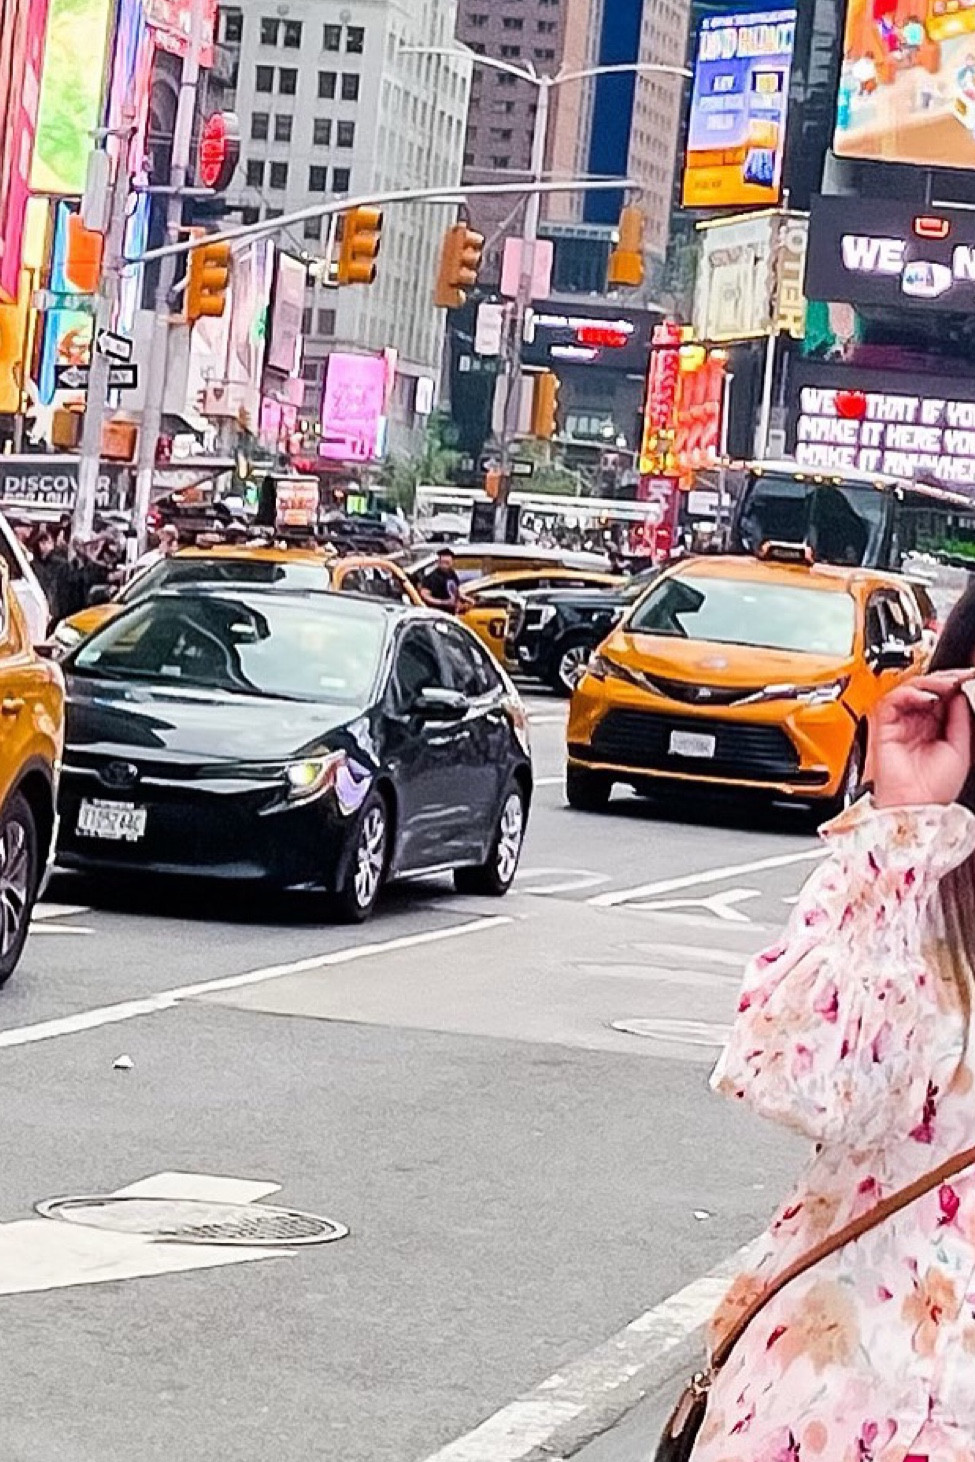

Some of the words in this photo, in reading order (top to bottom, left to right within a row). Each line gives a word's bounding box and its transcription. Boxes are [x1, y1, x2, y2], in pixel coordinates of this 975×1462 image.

[841, 235, 904, 275] WE
[801, 388, 837, 415] WE
[866, 393, 919, 422] THAT
[921, 398, 946, 425] IF
[797, 415, 858, 443] MAKE
[860, 421, 884, 447] IT
[886, 424, 942, 453] HERE
[795, 442, 856, 469] MAKE
[859, 448, 882, 473] IT
[5, 476, 111, 492] DISCOVR
